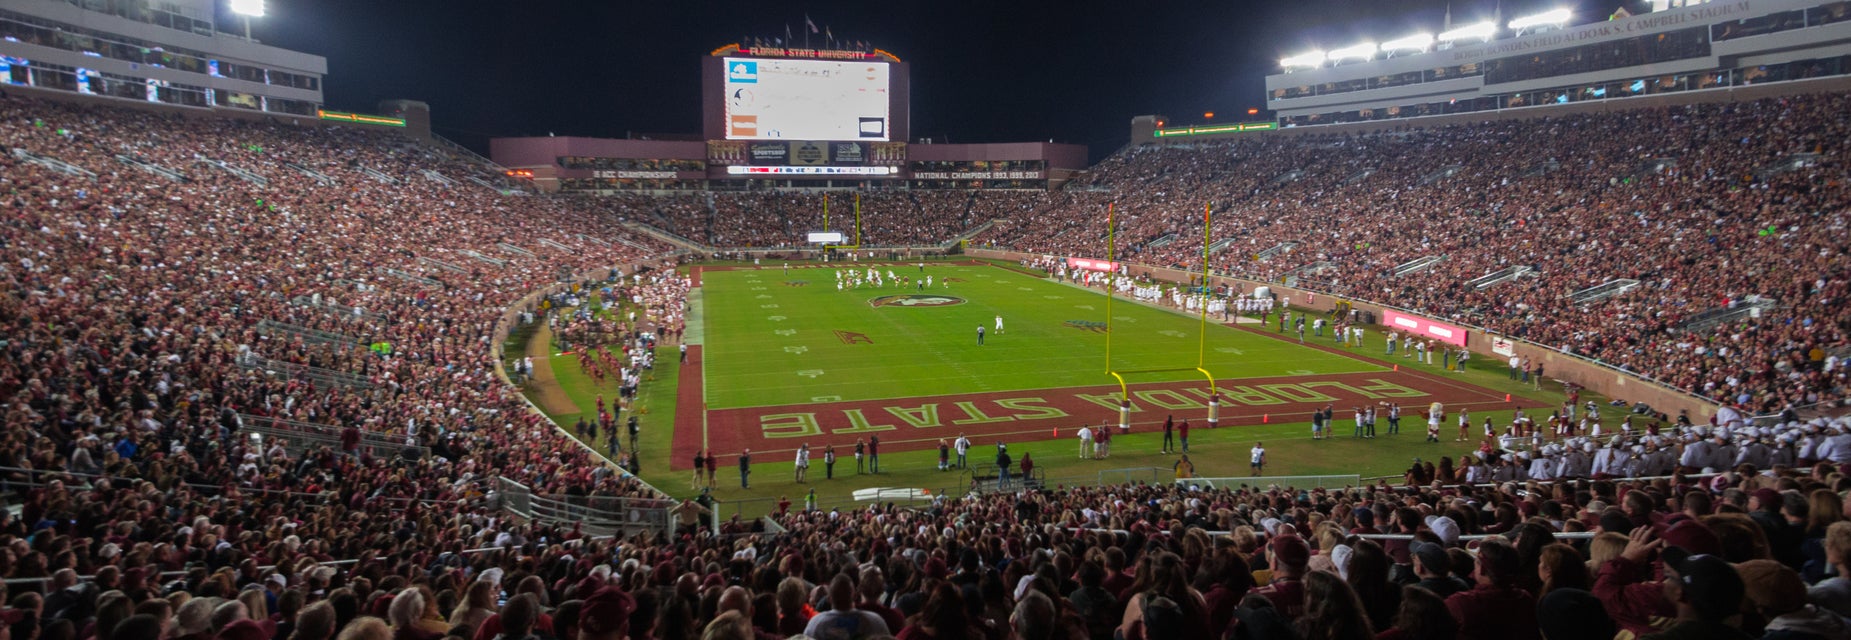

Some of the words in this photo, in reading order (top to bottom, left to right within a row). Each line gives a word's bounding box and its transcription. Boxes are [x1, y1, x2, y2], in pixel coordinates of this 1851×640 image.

[1487, 41, 1531, 55] BOWDEN
[1533, 35, 1562, 48] FIELD
[1579, 26, 1610, 39] DOAK
[1614, 23, 1624, 33] S.
[1627, 13, 1685, 32] CAMPBELL
[1690, 1, 1750, 20] STADIUM
[749, 46, 786, 57] FLORIDA
[788, 48, 815, 58] STATE
[818, 49, 866, 59] UNIVERSITY
[602, 170, 617, 178] ACC
[618, 170, 677, 179] CHAMPIONSHIPS
[1075, 378, 1433, 413] FLORIDA
[760, 397, 1069, 438] STATE
